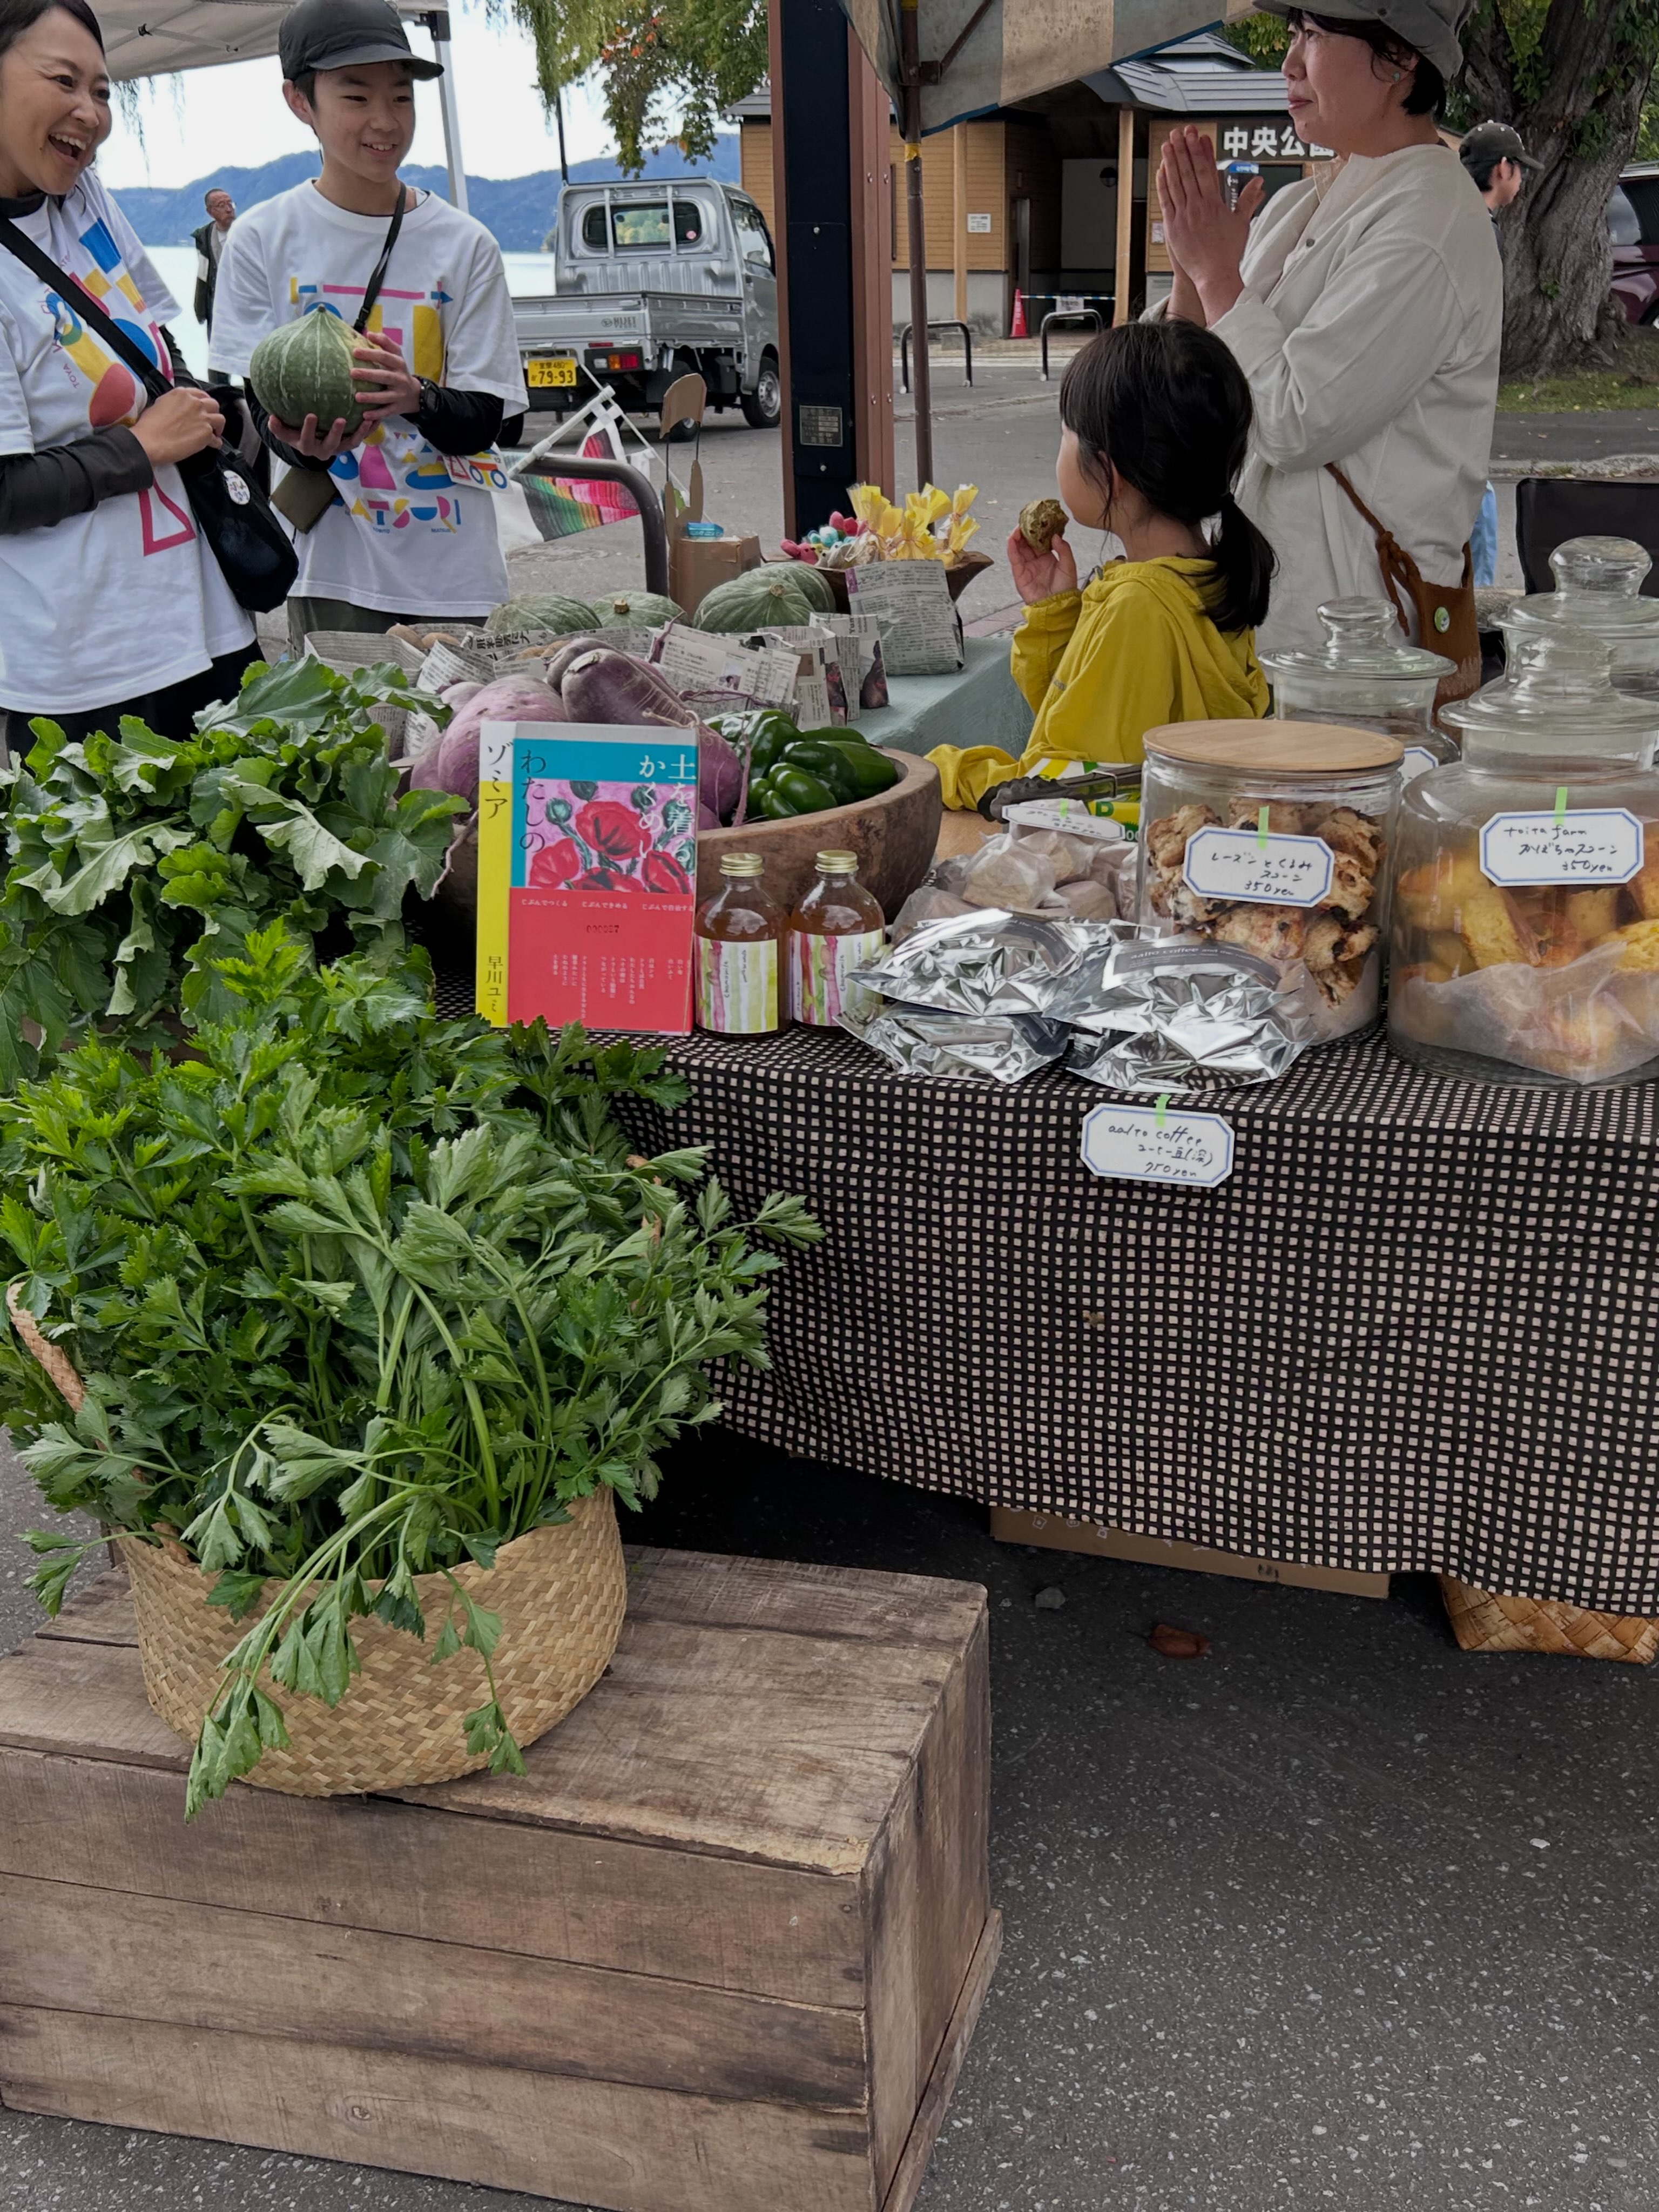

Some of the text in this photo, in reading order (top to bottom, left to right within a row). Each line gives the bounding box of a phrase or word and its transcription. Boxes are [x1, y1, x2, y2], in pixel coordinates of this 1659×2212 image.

[485, 742, 514, 819] ゾミア
[520, 749, 547, 853] わたしの
[639, 755, 666, 859] かくめい
[668, 754, 696, 862] 土を着る
[1552, 824, 1587, 840] farm
[485, 956, 503, 1012] 早川ユミ
[1109, 1124, 1202, 1146] aalto coffee
